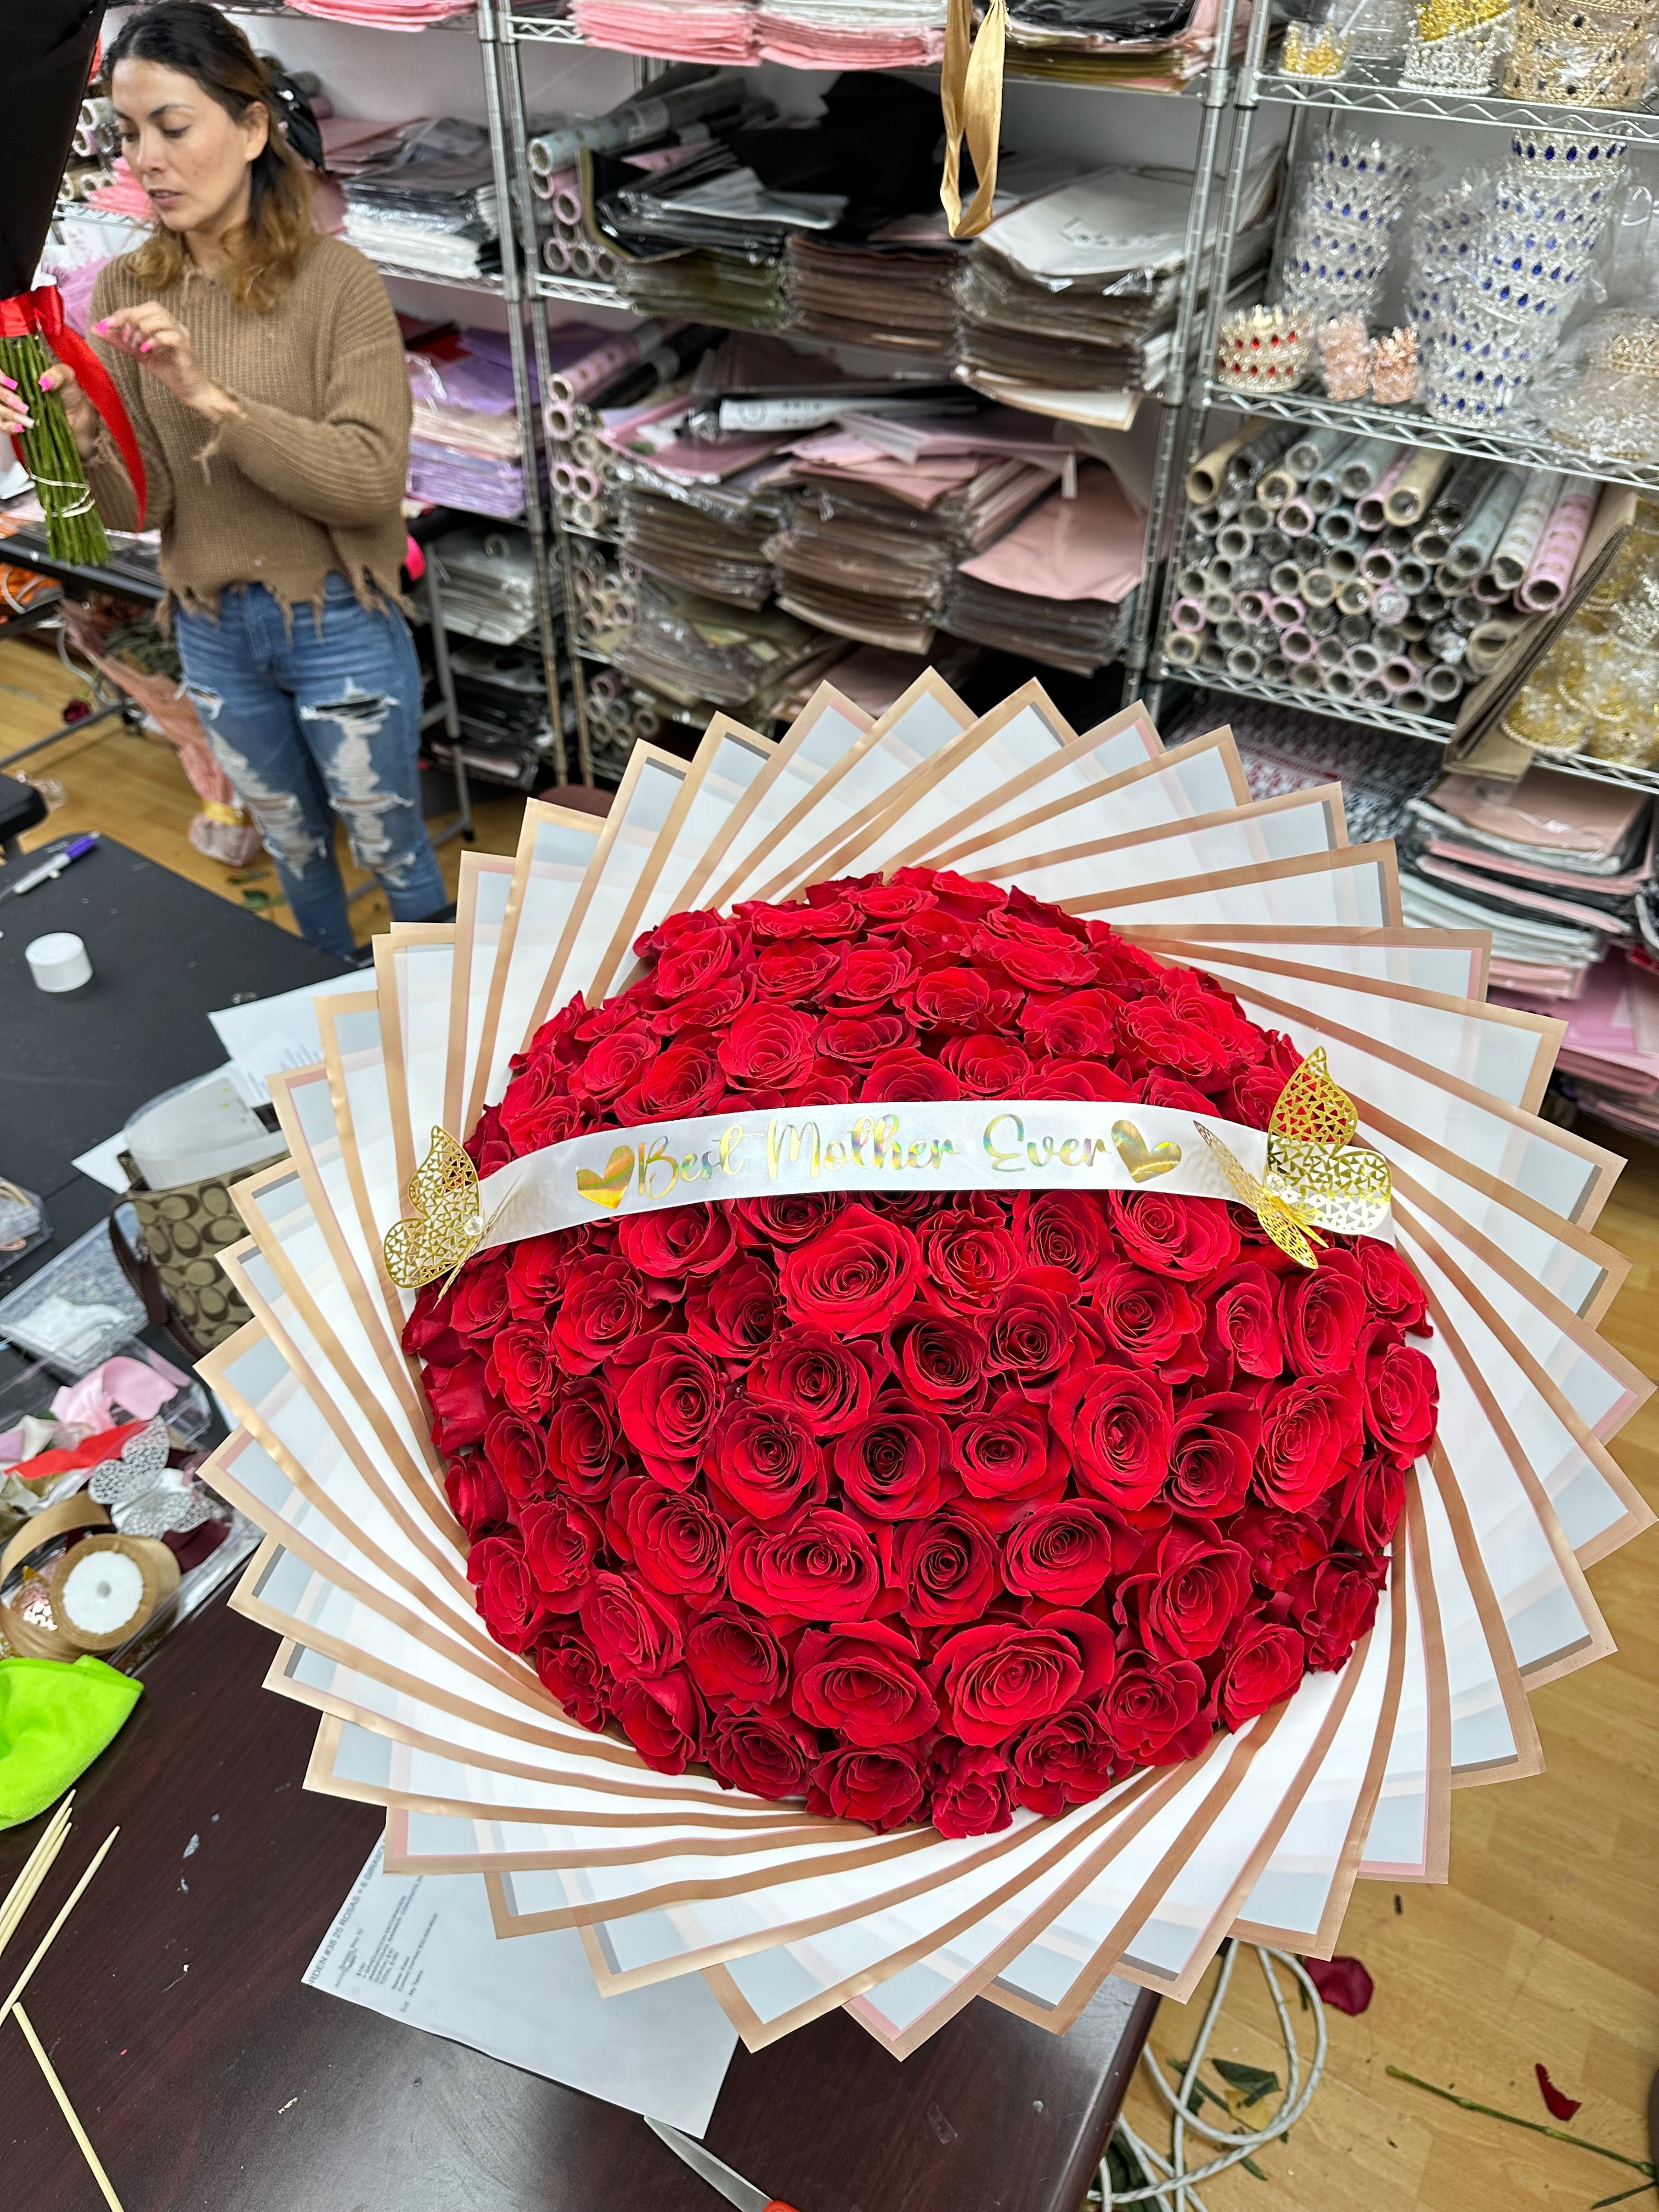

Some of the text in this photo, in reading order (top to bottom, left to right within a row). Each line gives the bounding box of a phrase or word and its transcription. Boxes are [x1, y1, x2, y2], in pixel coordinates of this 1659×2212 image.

[638, 1113, 1111, 1199] Best Mother Ever
[341, 1895, 360, 1926] ROSAS
